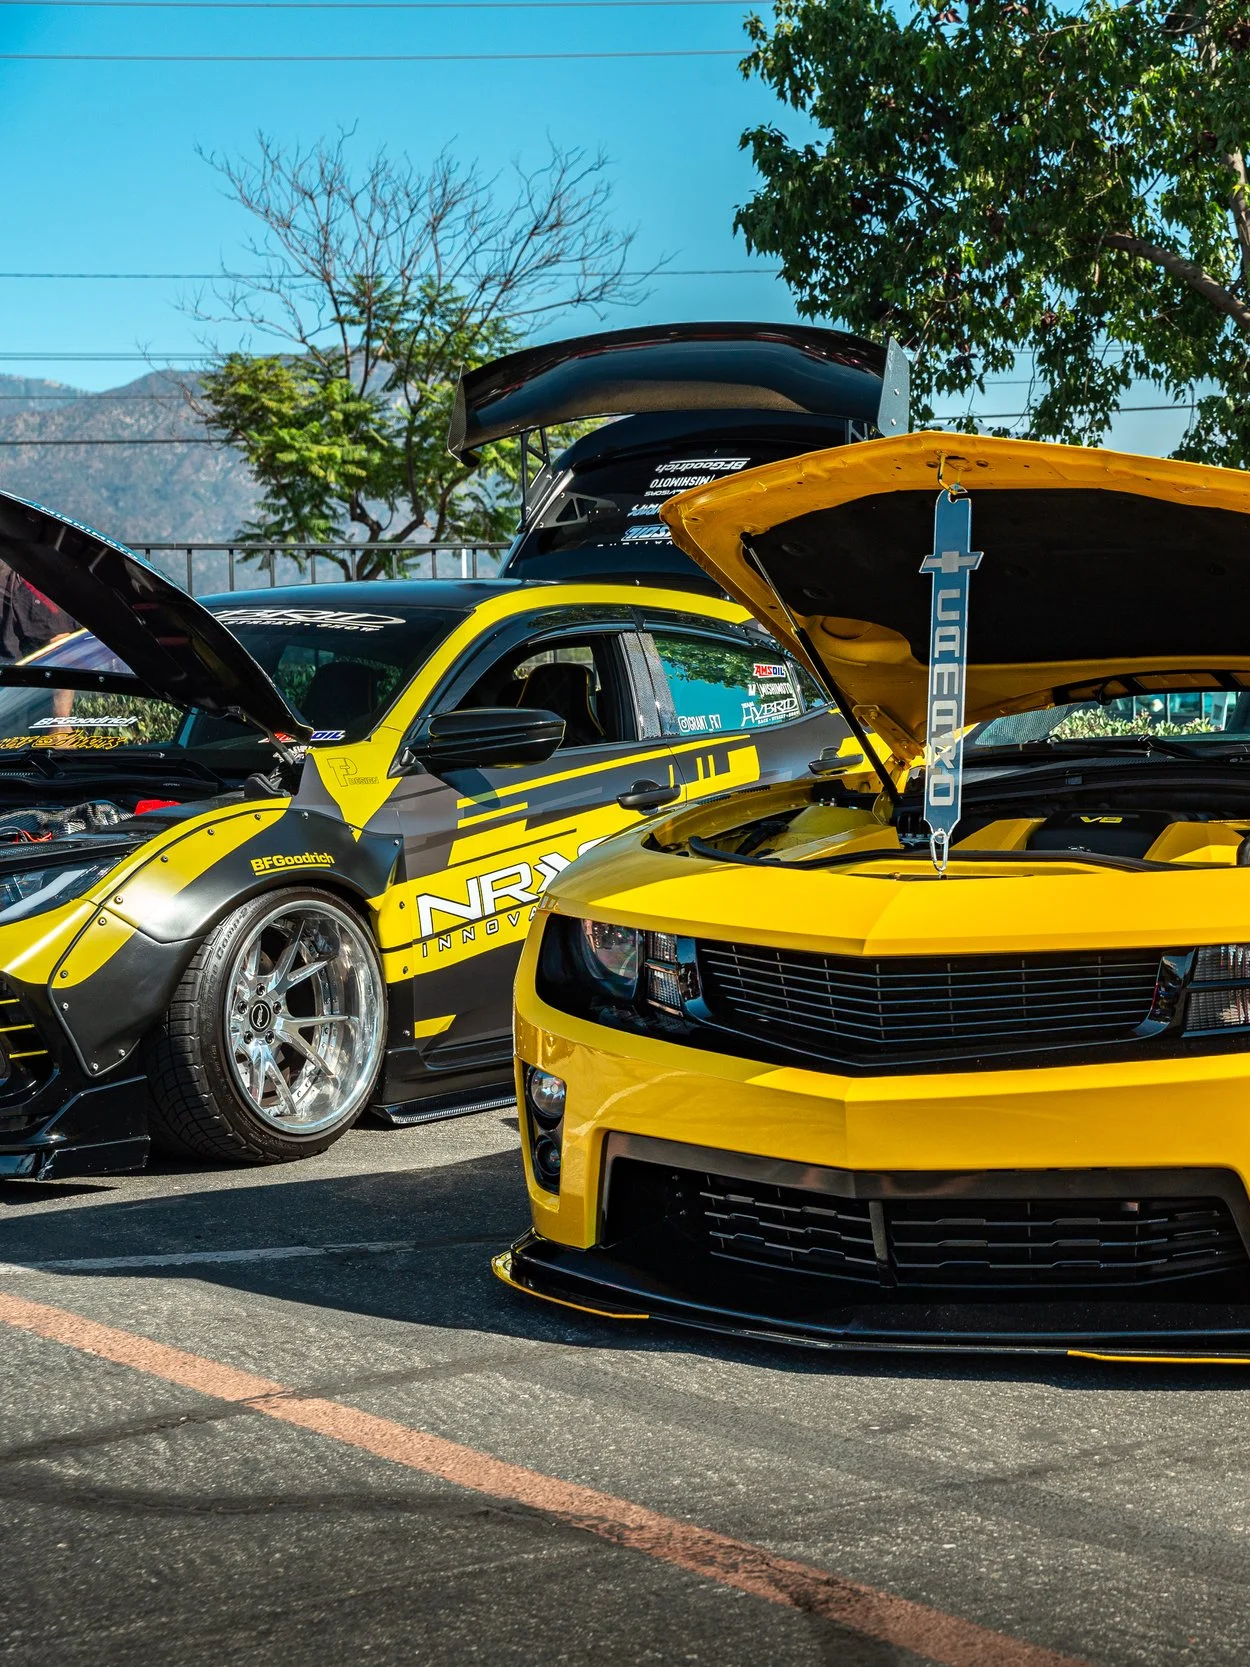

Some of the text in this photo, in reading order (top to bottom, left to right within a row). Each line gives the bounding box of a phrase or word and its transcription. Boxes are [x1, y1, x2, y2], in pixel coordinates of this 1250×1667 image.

[655, 460, 748, 473] BFGoodrich
[650, 474, 715, 488] MISHIMOTO
[754, 664, 785, 677] AMSOIL
[741, 698, 798, 726] HYBRID
[31, 715, 140, 727] BFGoodrich
[250, 852, 335, 874] BFGoodrich
